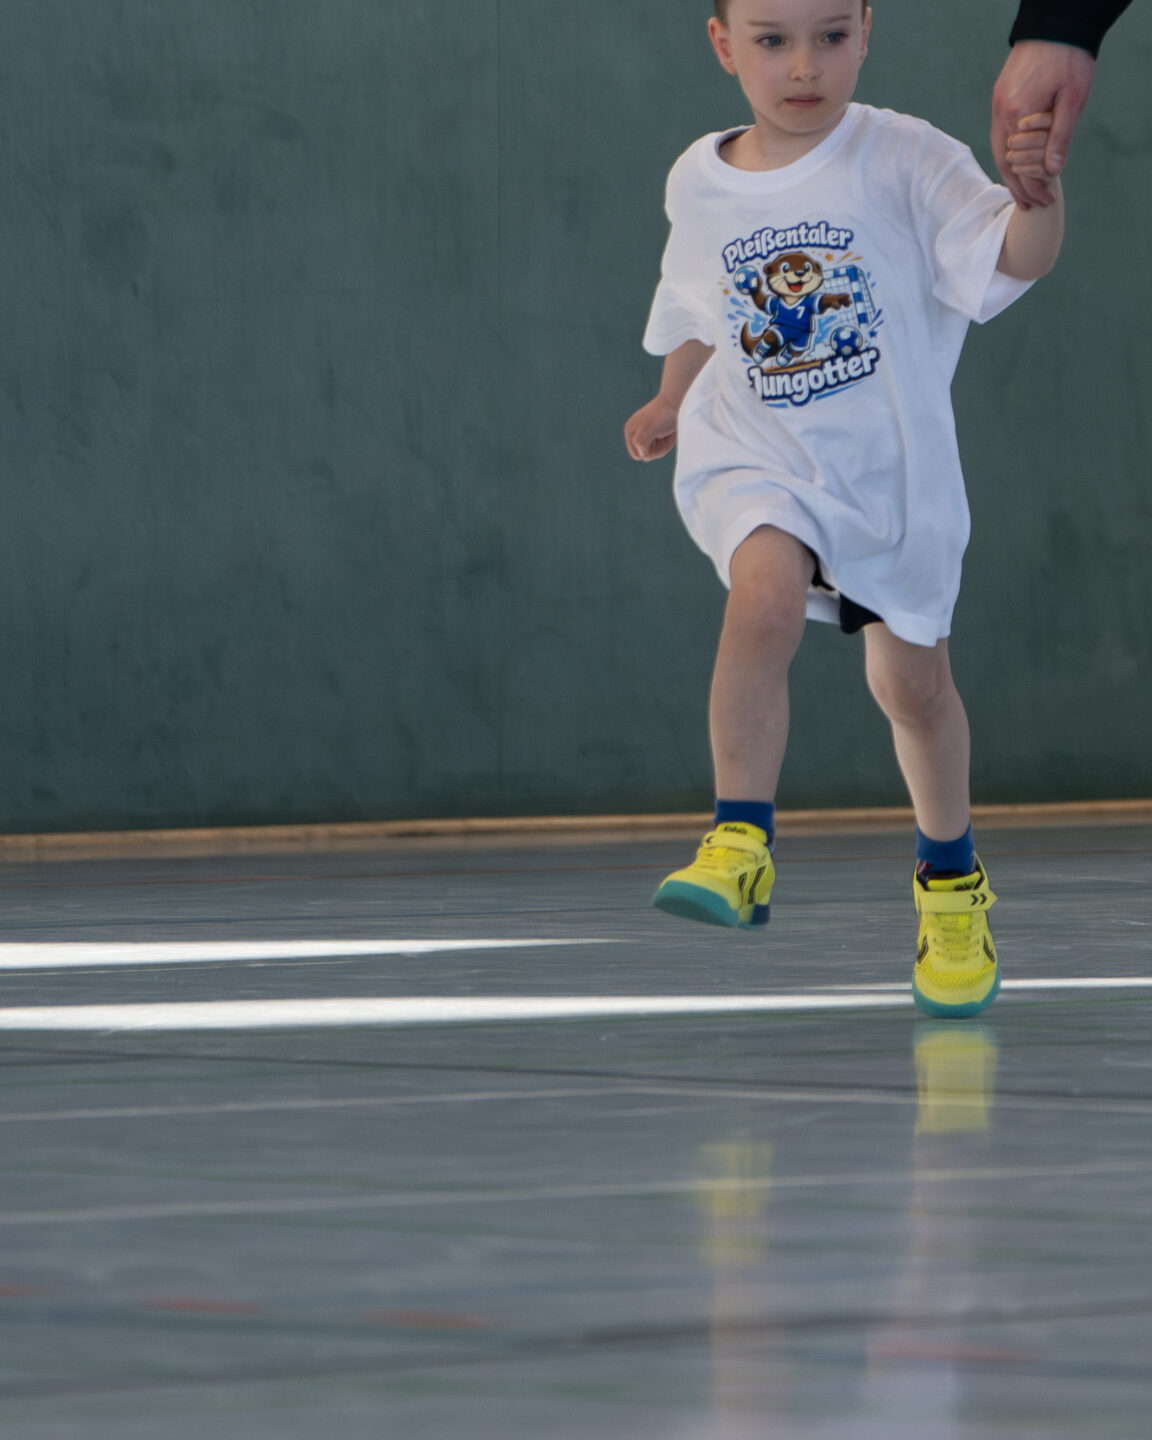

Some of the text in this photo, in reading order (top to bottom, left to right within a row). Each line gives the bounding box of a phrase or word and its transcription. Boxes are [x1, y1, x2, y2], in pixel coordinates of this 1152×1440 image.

[722, 220, 854, 273] Pleißentaler
[797, 305, 806, 319] 7
[748, 347, 881, 406] Jungotter
